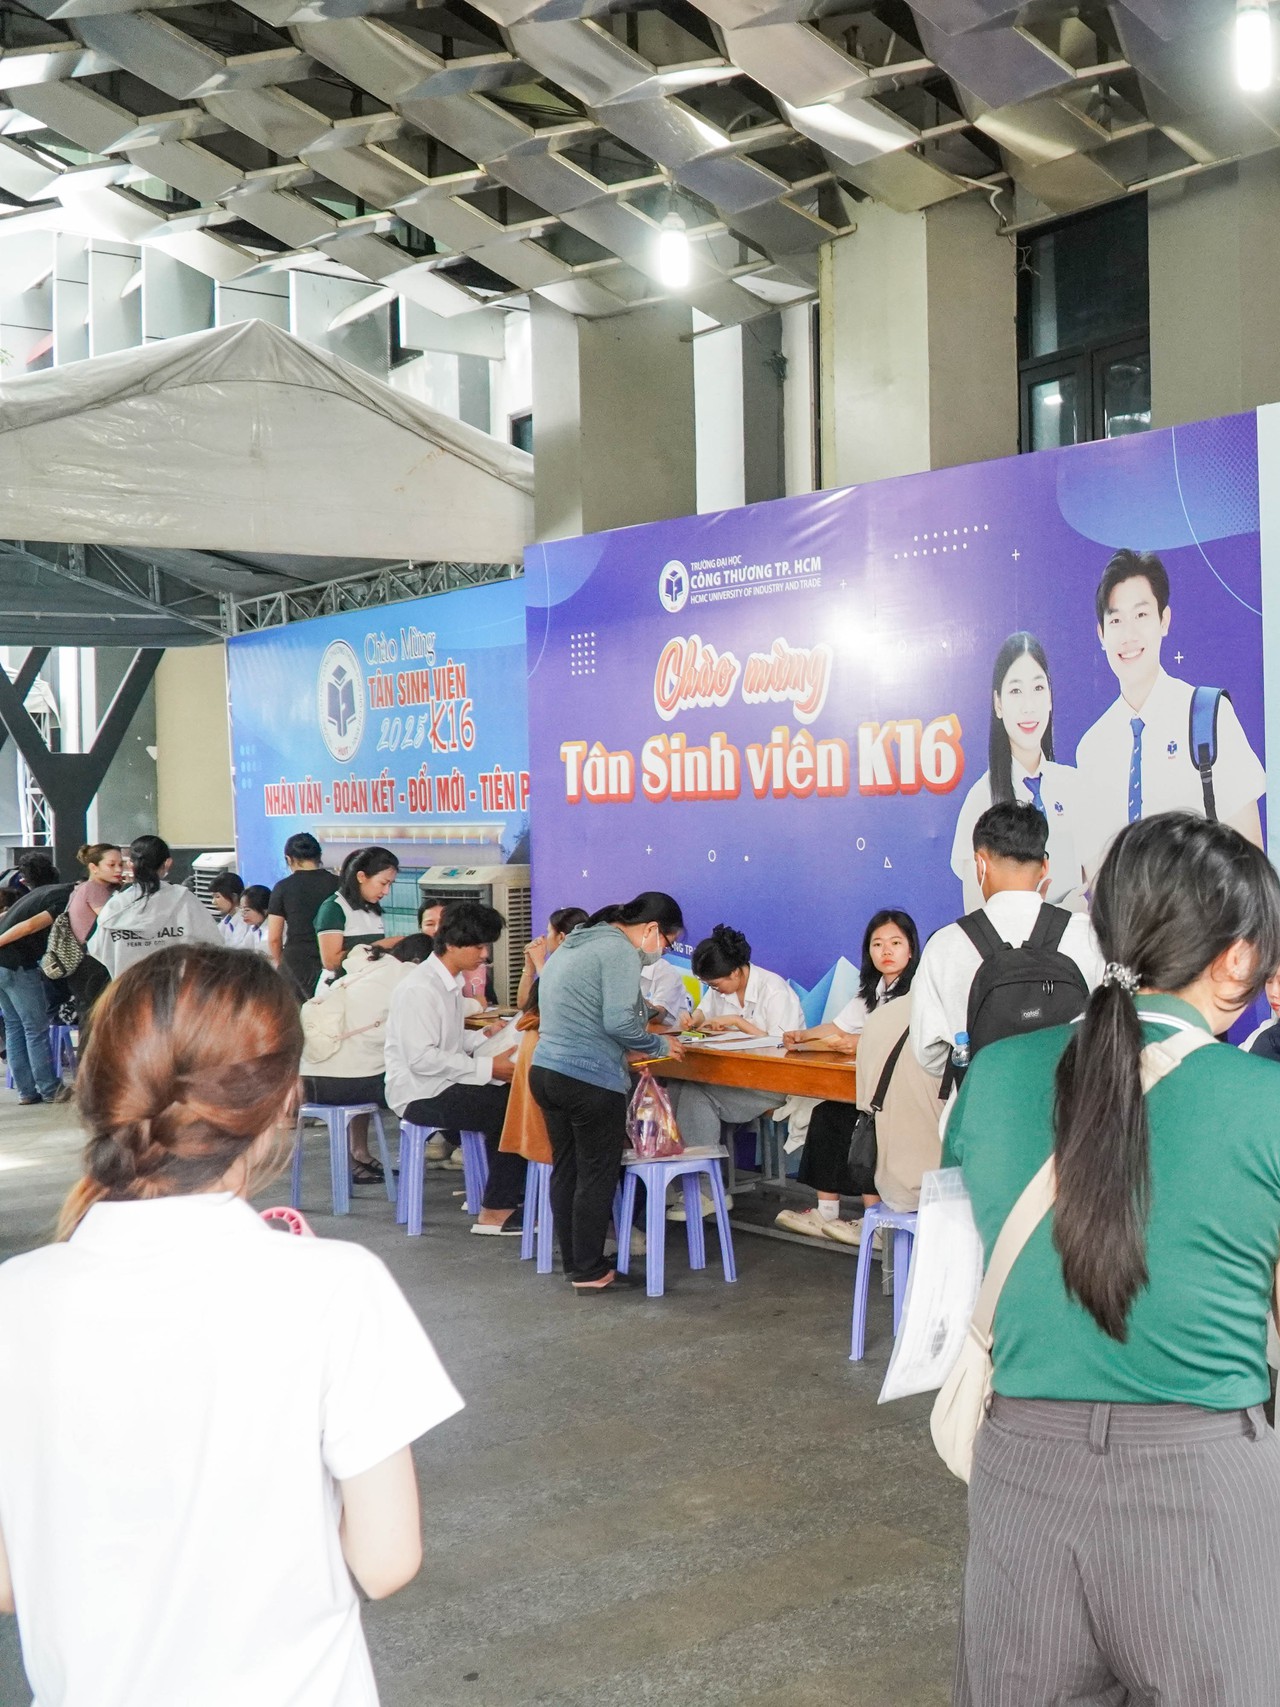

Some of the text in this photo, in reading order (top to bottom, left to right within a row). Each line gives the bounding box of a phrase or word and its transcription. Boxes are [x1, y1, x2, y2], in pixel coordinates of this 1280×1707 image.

[691, 556, 821, 589] CÔNG THƯƠNG TP. HCM
[728, 555, 742, 566] HỌC
[691, 578, 821, 604] HCMC UNIVERSITY OF INDUSTRY AND TRADE
[365, 626, 436, 666] Chào Mừng
[368, 658, 466, 709] TÂN SINH VIÊN
[655, 636, 832, 723] Chào mừng
[377, 698, 475, 753] 2025 K16
[560, 714, 965, 804] Tân Sinh viên K16
[265, 761, 515, 816] NHÂN VĂN ĐOÀN KẾT ĐỔI MỚI TIÊN
